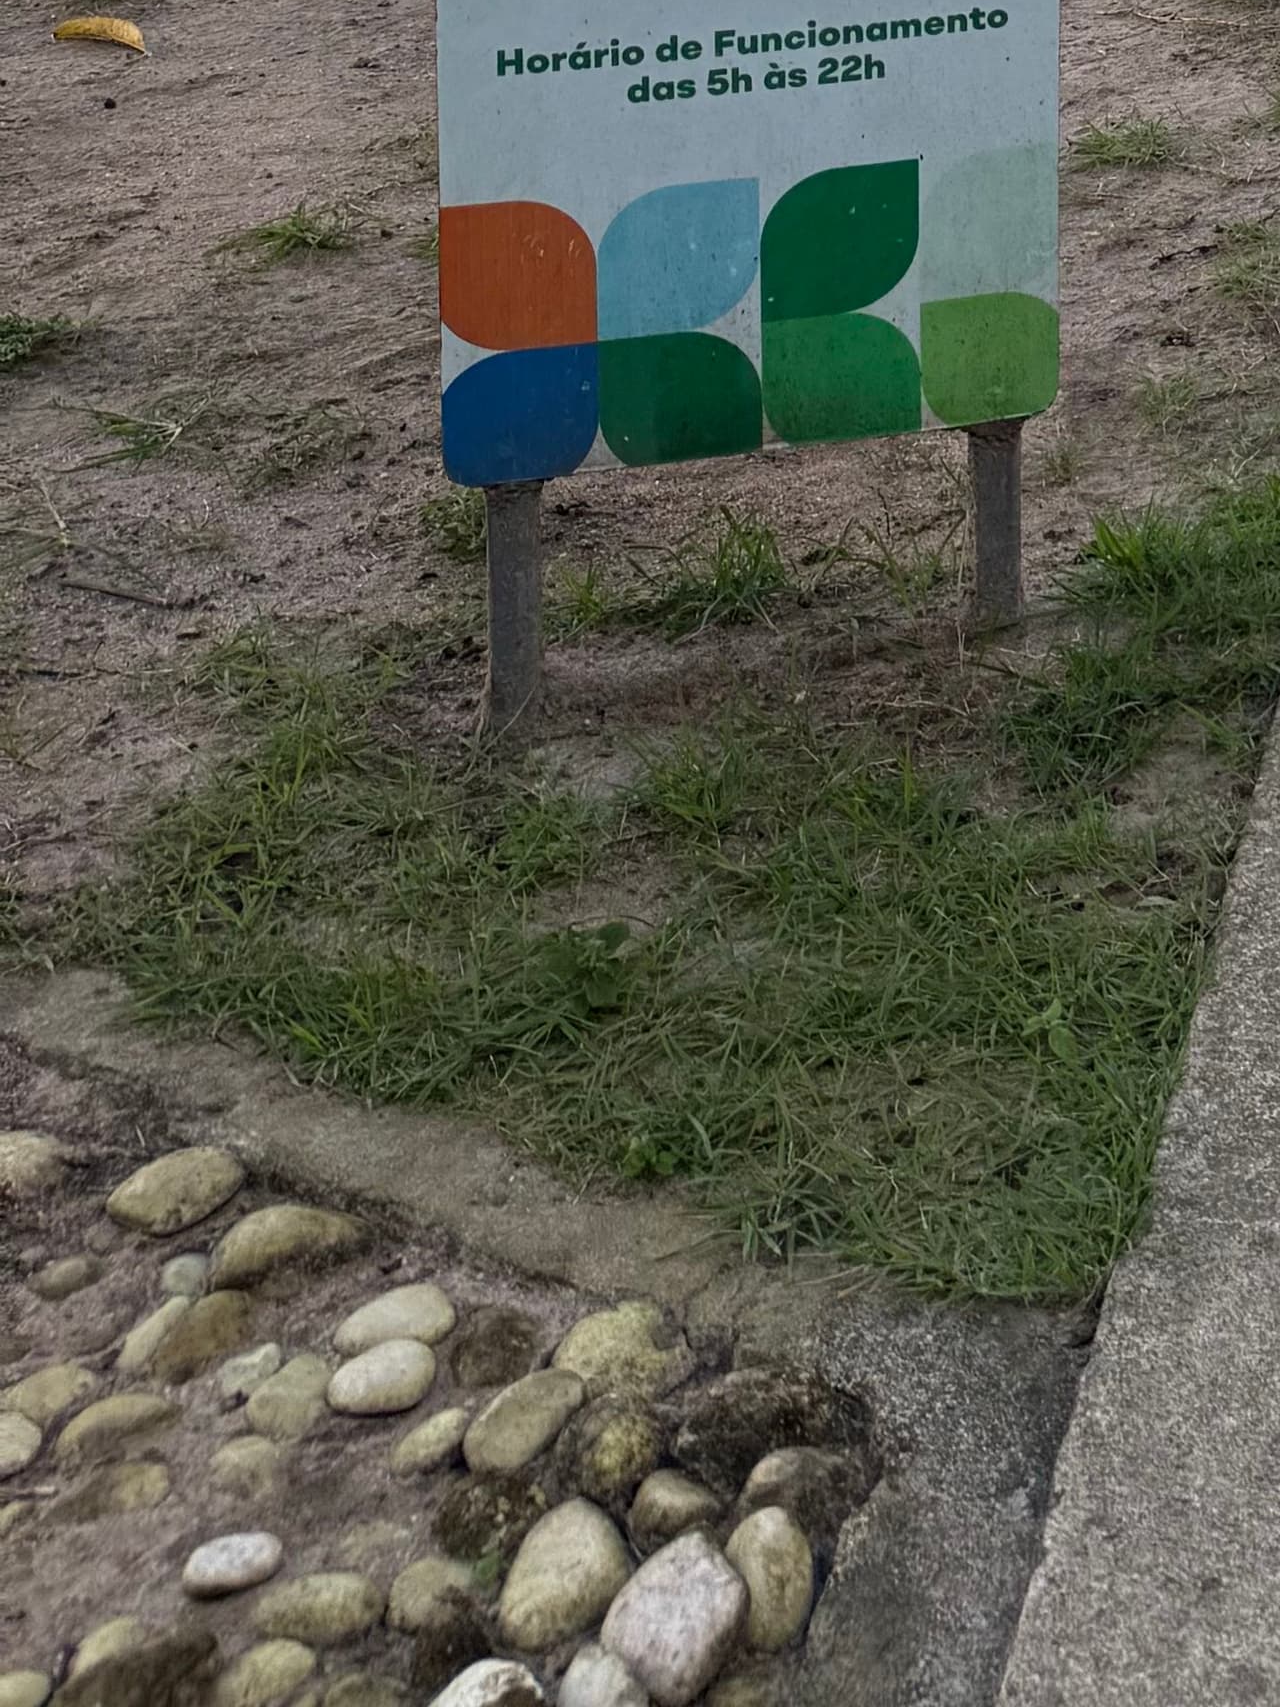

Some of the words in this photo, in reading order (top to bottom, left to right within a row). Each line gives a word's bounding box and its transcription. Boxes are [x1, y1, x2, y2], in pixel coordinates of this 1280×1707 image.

[497, 37, 645, 76] Horário
[655, 34, 703, 63] de
[714, 7, 1009, 57] Funcionamento
[627, 75, 697, 104] das
[707, 66, 753, 96] 5h
[763, 62, 808, 90] às
[817, 53, 886, 85] 22h
